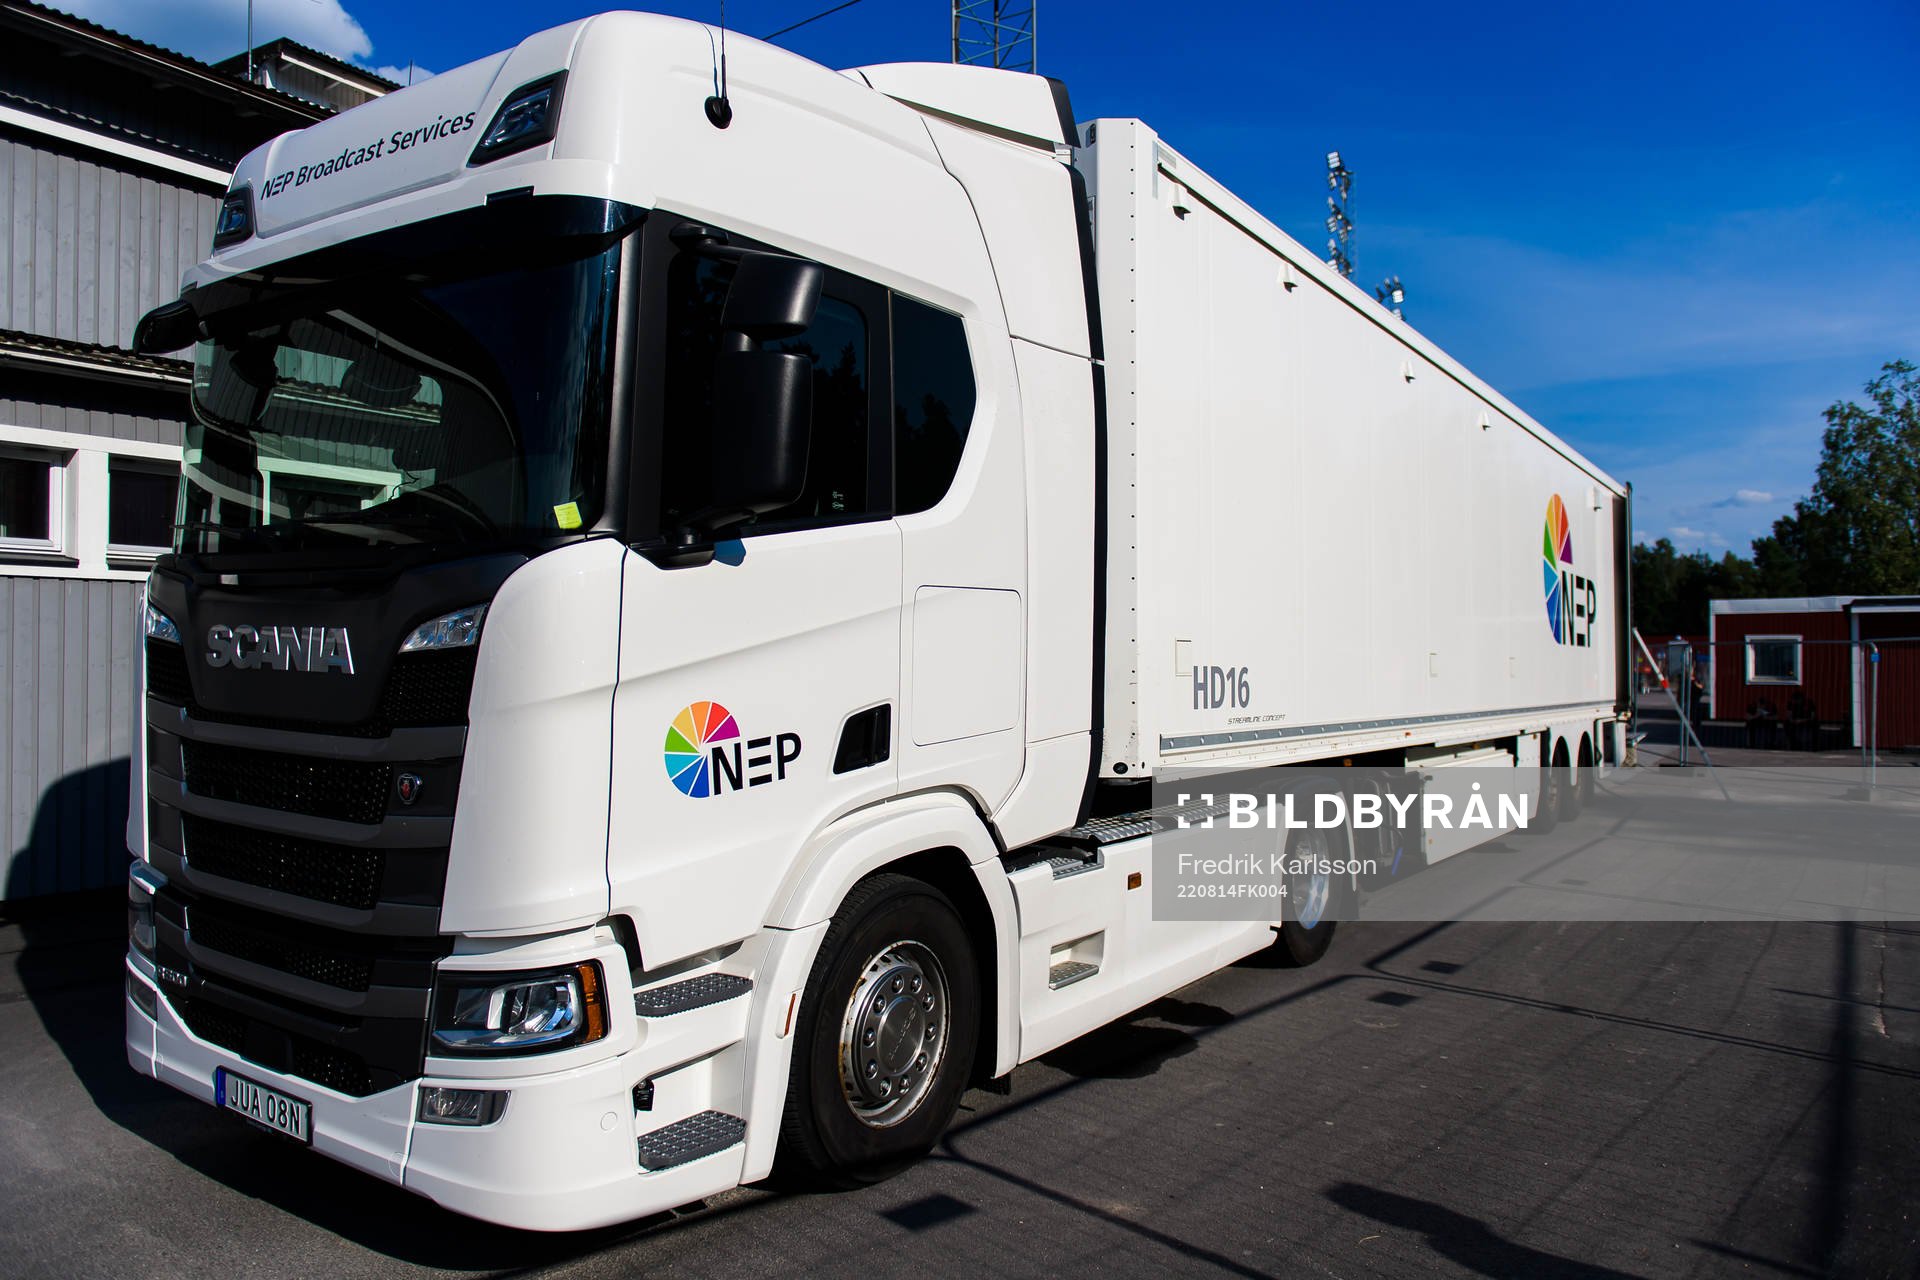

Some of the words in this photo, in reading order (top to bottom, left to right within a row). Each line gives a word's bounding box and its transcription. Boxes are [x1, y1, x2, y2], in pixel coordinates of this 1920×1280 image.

[261, 170, 295, 200] NEP
[295, 138, 385, 187] Broadcast
[387, 111, 476, 154] Services
[1562, 570, 1597, 648] NEP
[205, 624, 354, 675] SCANIA
[1193, 665, 1250, 710] HD16
[1227, 715, 1261, 725] STREAMLINE
[1262, 713, 1286, 722] CONCEPT
[711, 732, 802, 796] NEP
[231, 1080, 262, 1118] JUA
